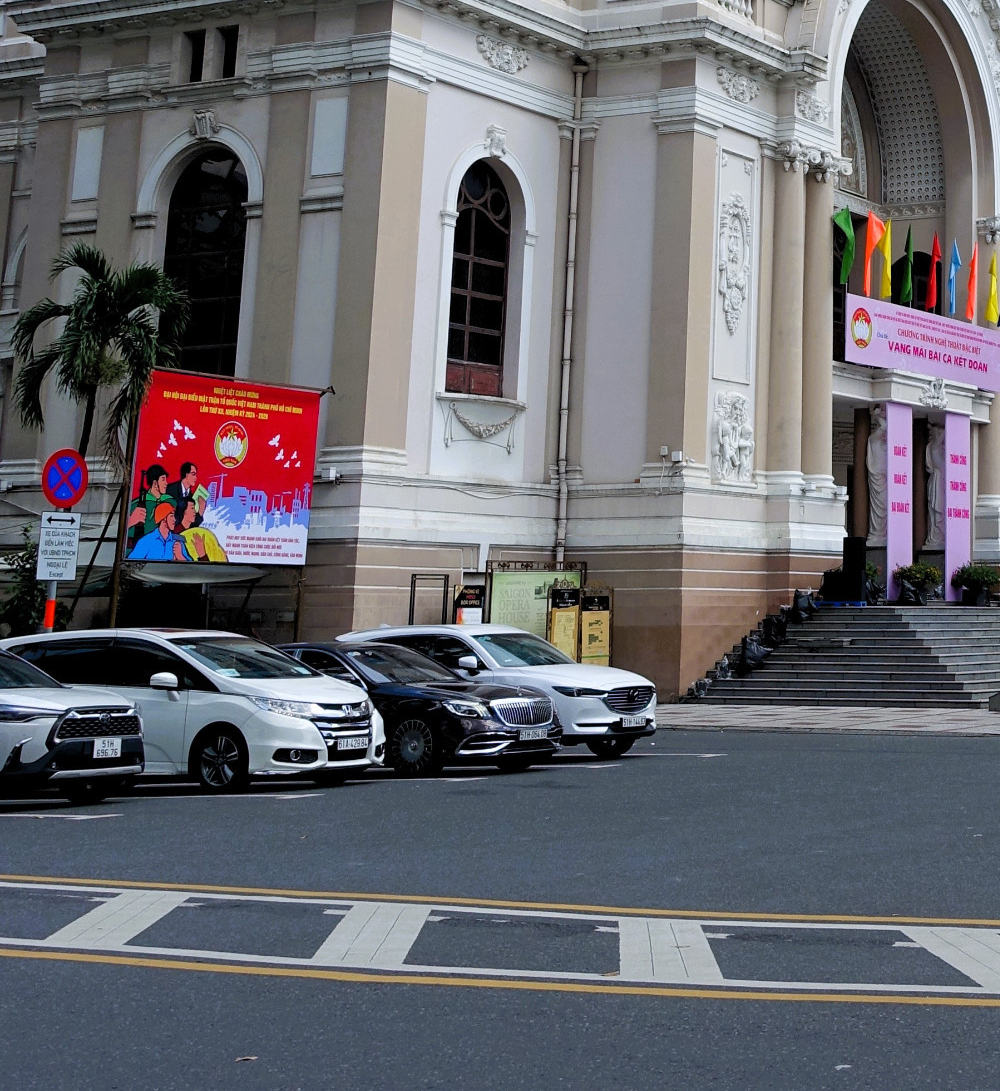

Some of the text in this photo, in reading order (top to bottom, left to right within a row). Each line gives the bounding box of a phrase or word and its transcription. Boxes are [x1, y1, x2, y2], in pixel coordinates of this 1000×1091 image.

[943, 354, 952, 363] CA
[500, 588, 531, 599] SAIGON
[499, 600, 530, 611] OPERA
[498, 612, 530, 624] HOUSE
[101, 740, 115, 749] 51H
[97, 748, 119, 757] 696.76
